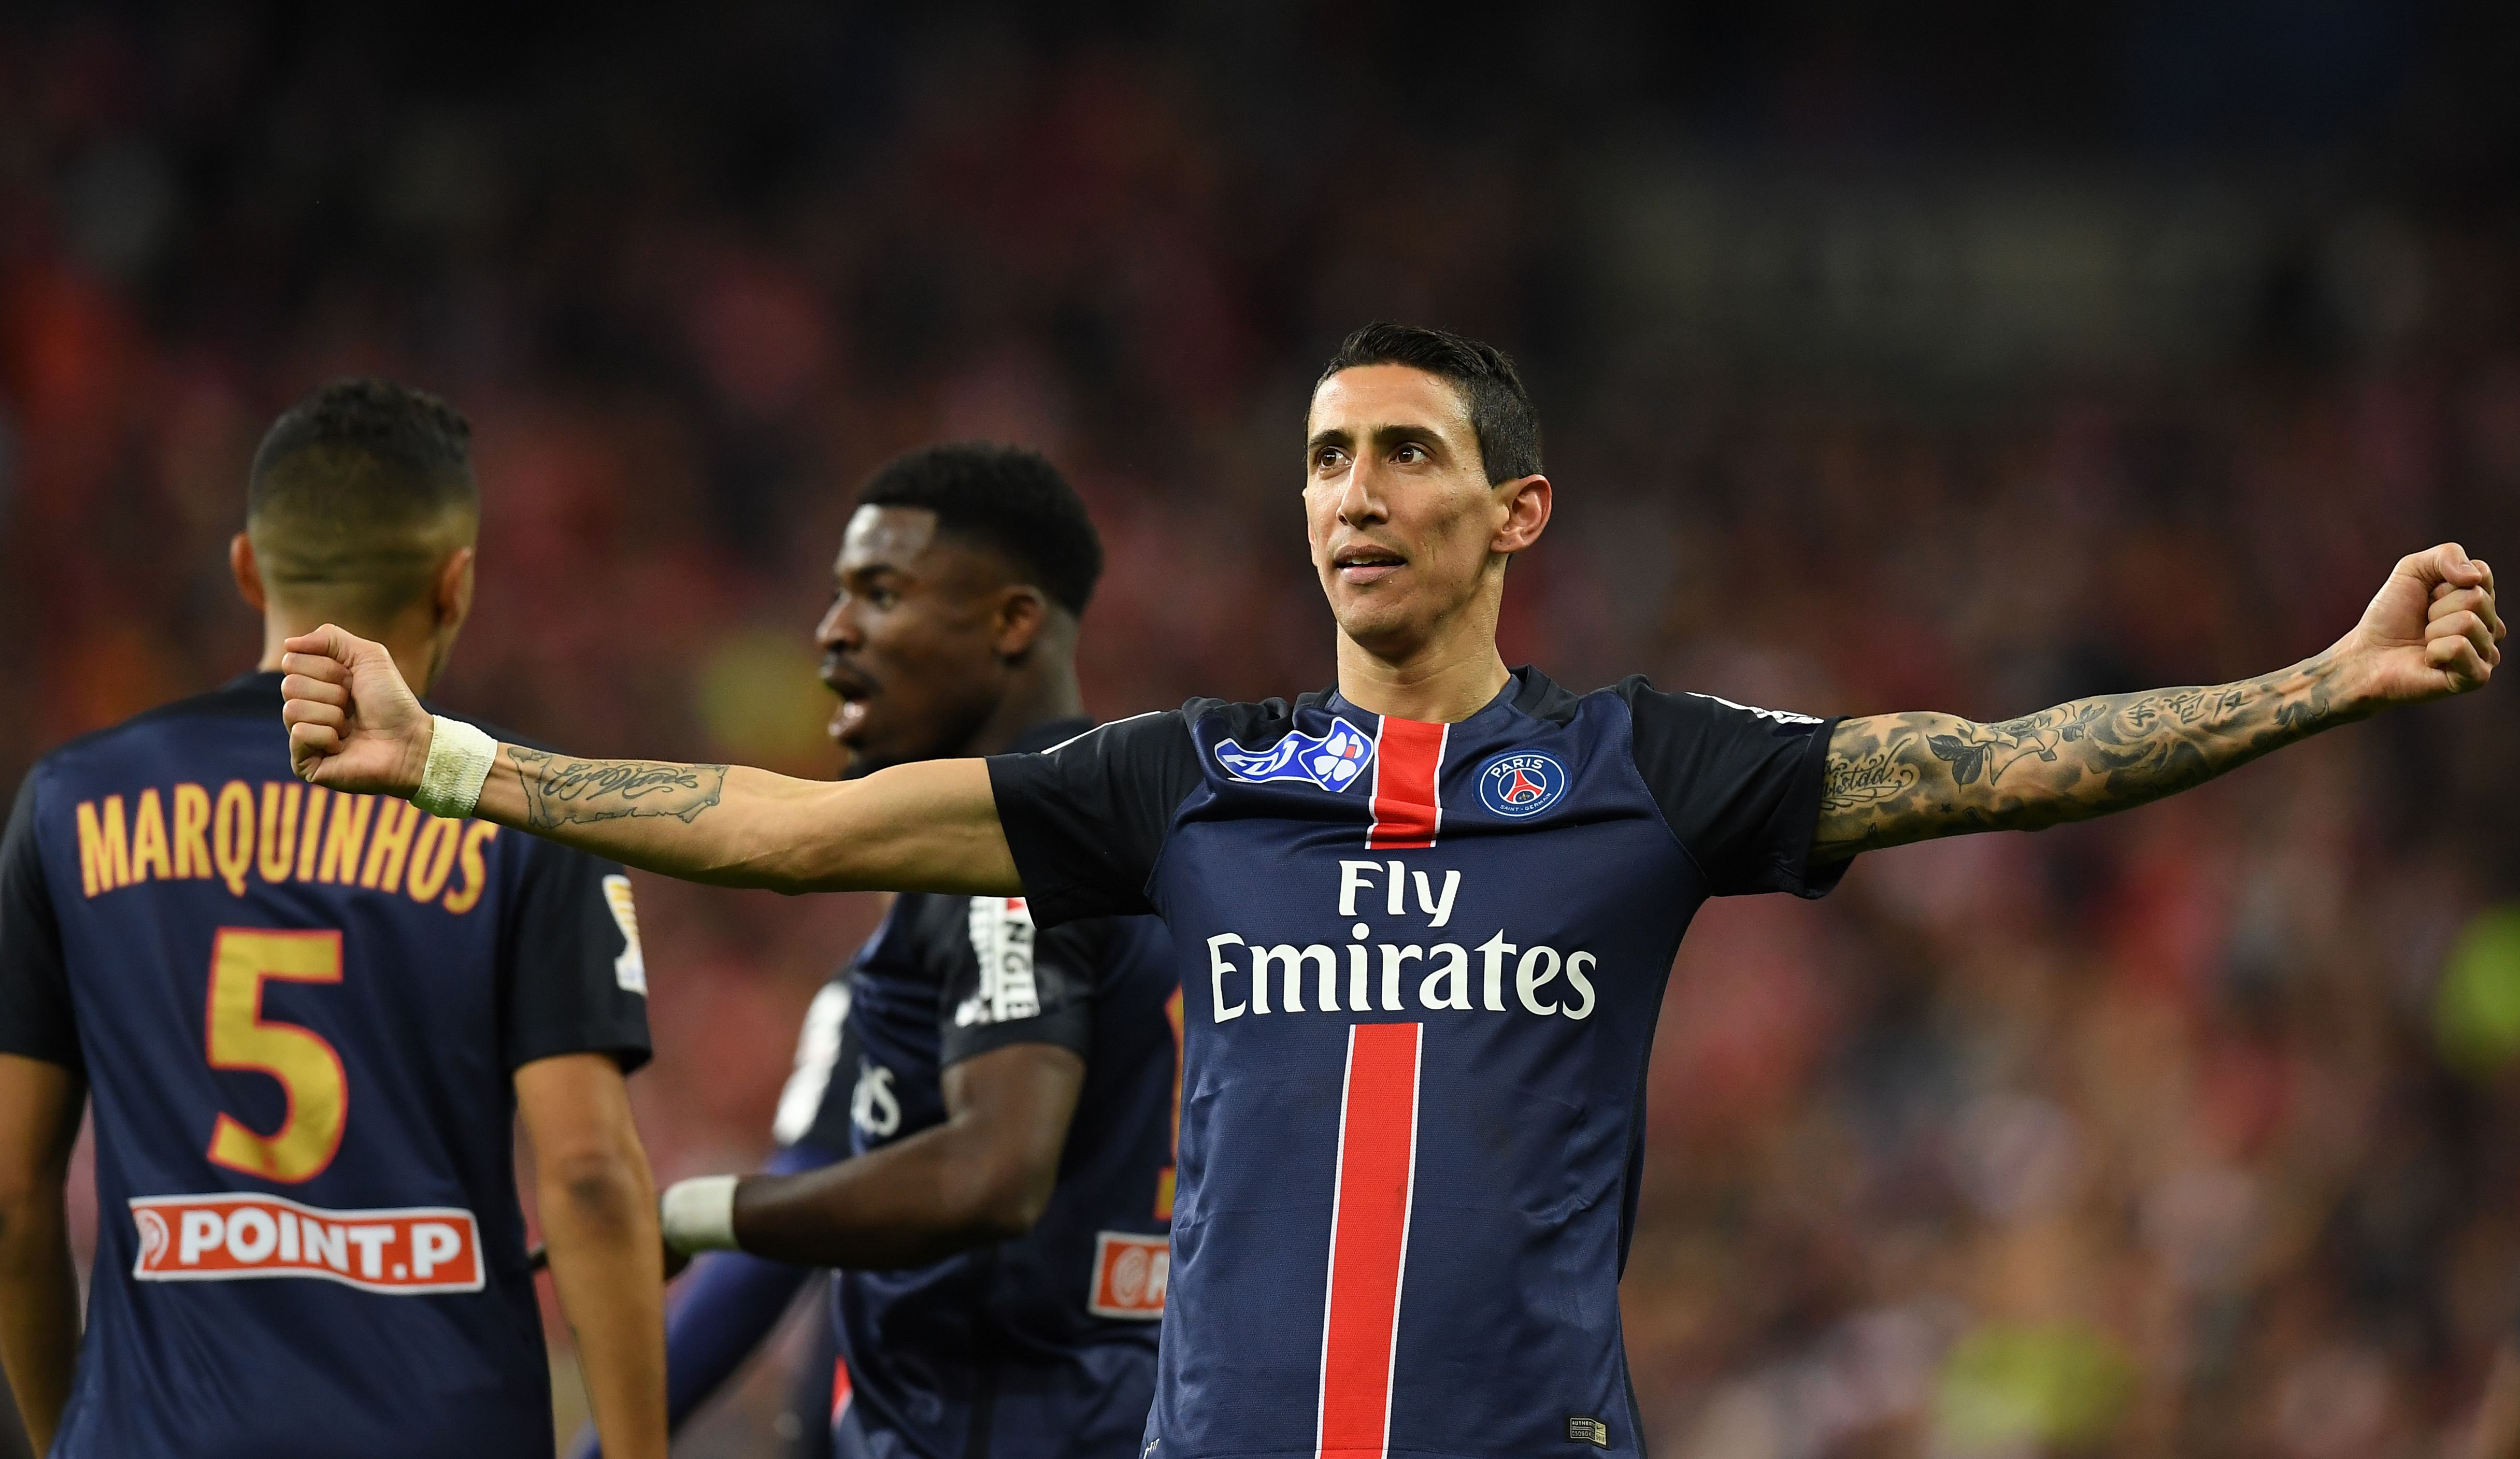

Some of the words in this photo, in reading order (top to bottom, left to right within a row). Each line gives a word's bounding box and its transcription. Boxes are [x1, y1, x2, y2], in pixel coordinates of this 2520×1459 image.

[1491, 758, 1544, 778] PARIS
[76, 779, 502, 914] MARQUINHOS
[1338, 860, 1461, 927] Fly
[1207, 923, 1597, 1023] Emirates
[205, 926, 349, 1184] 5
[179, 1207, 461, 1279] POINT.P
